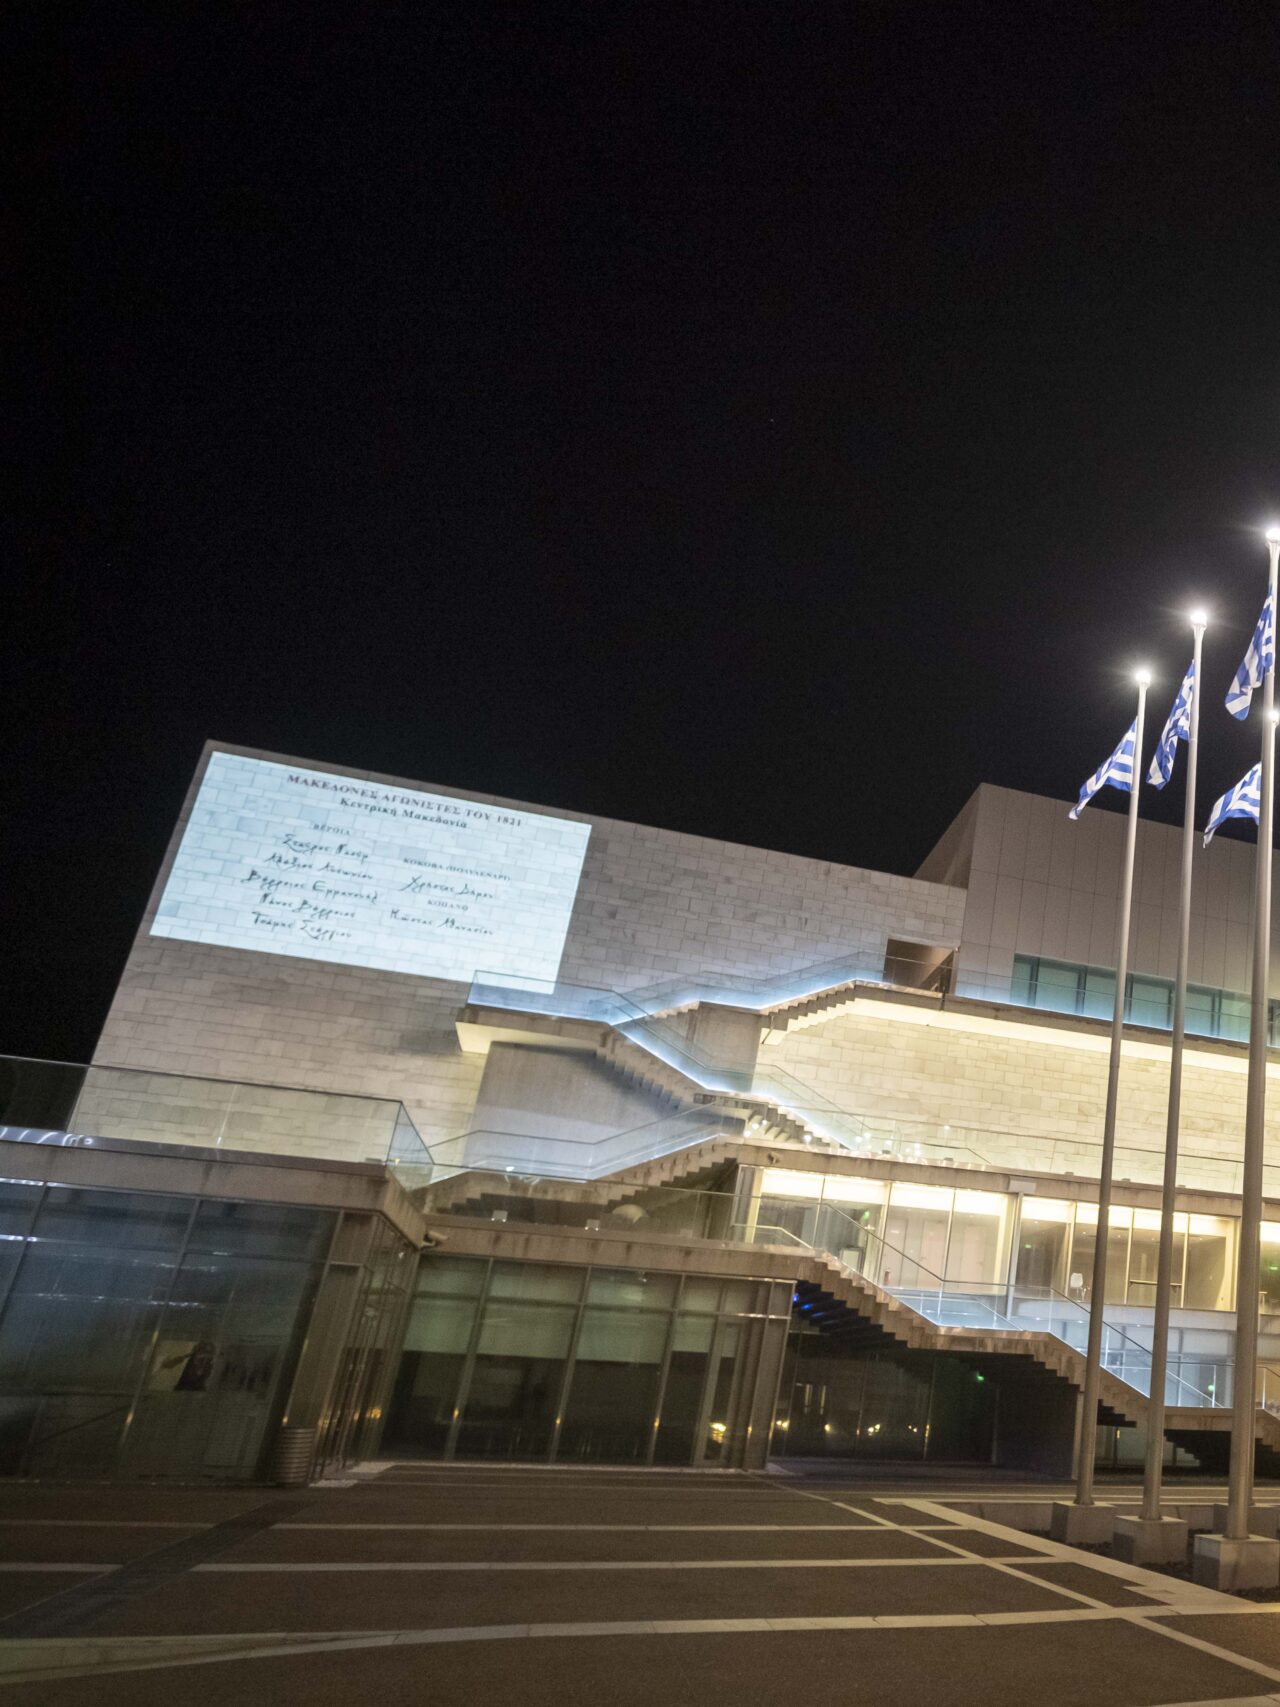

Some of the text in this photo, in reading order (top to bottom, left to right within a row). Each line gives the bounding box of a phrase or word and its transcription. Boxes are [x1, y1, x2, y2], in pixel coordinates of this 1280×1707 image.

[287, 774, 522, 828] ΜΑΚΕΔΟΝΕΣ ΑΓΩΝΙΣΤΕΣ ΤΟΥ 1821
[340, 798, 468, 828] Κεντρική Μακεδονία
